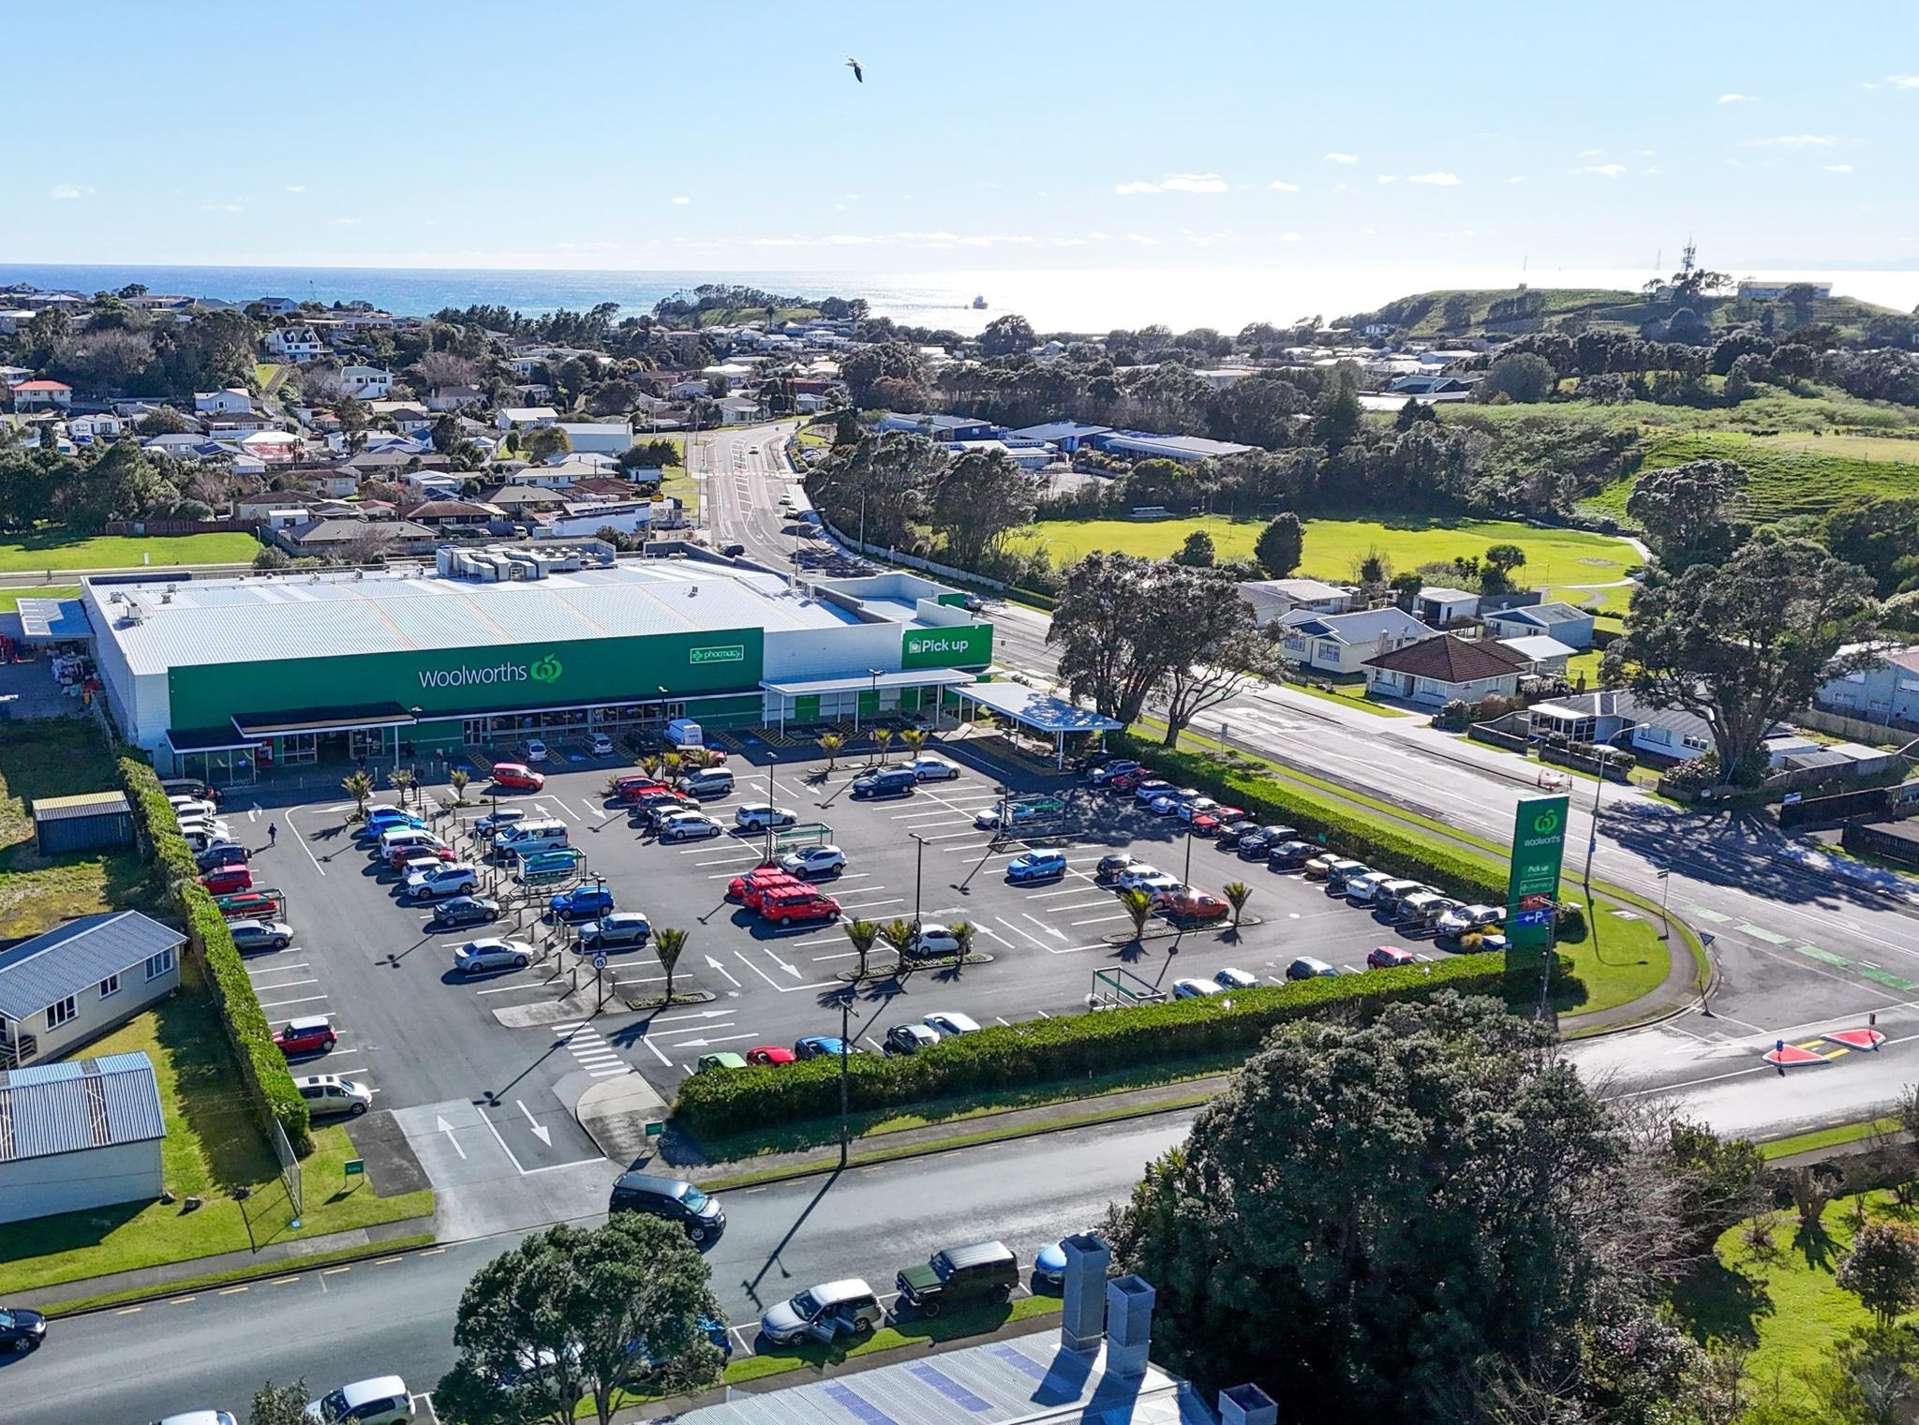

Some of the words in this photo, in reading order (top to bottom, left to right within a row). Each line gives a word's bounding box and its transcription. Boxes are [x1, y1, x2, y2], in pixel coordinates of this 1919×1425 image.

[922, 639, 949, 653] Pick
[952, 640, 969, 653] up
[703, 650, 741, 660] pharmacy
[418, 661, 528, 689] Woolworths
[1534, 911, 1544, 924] P
